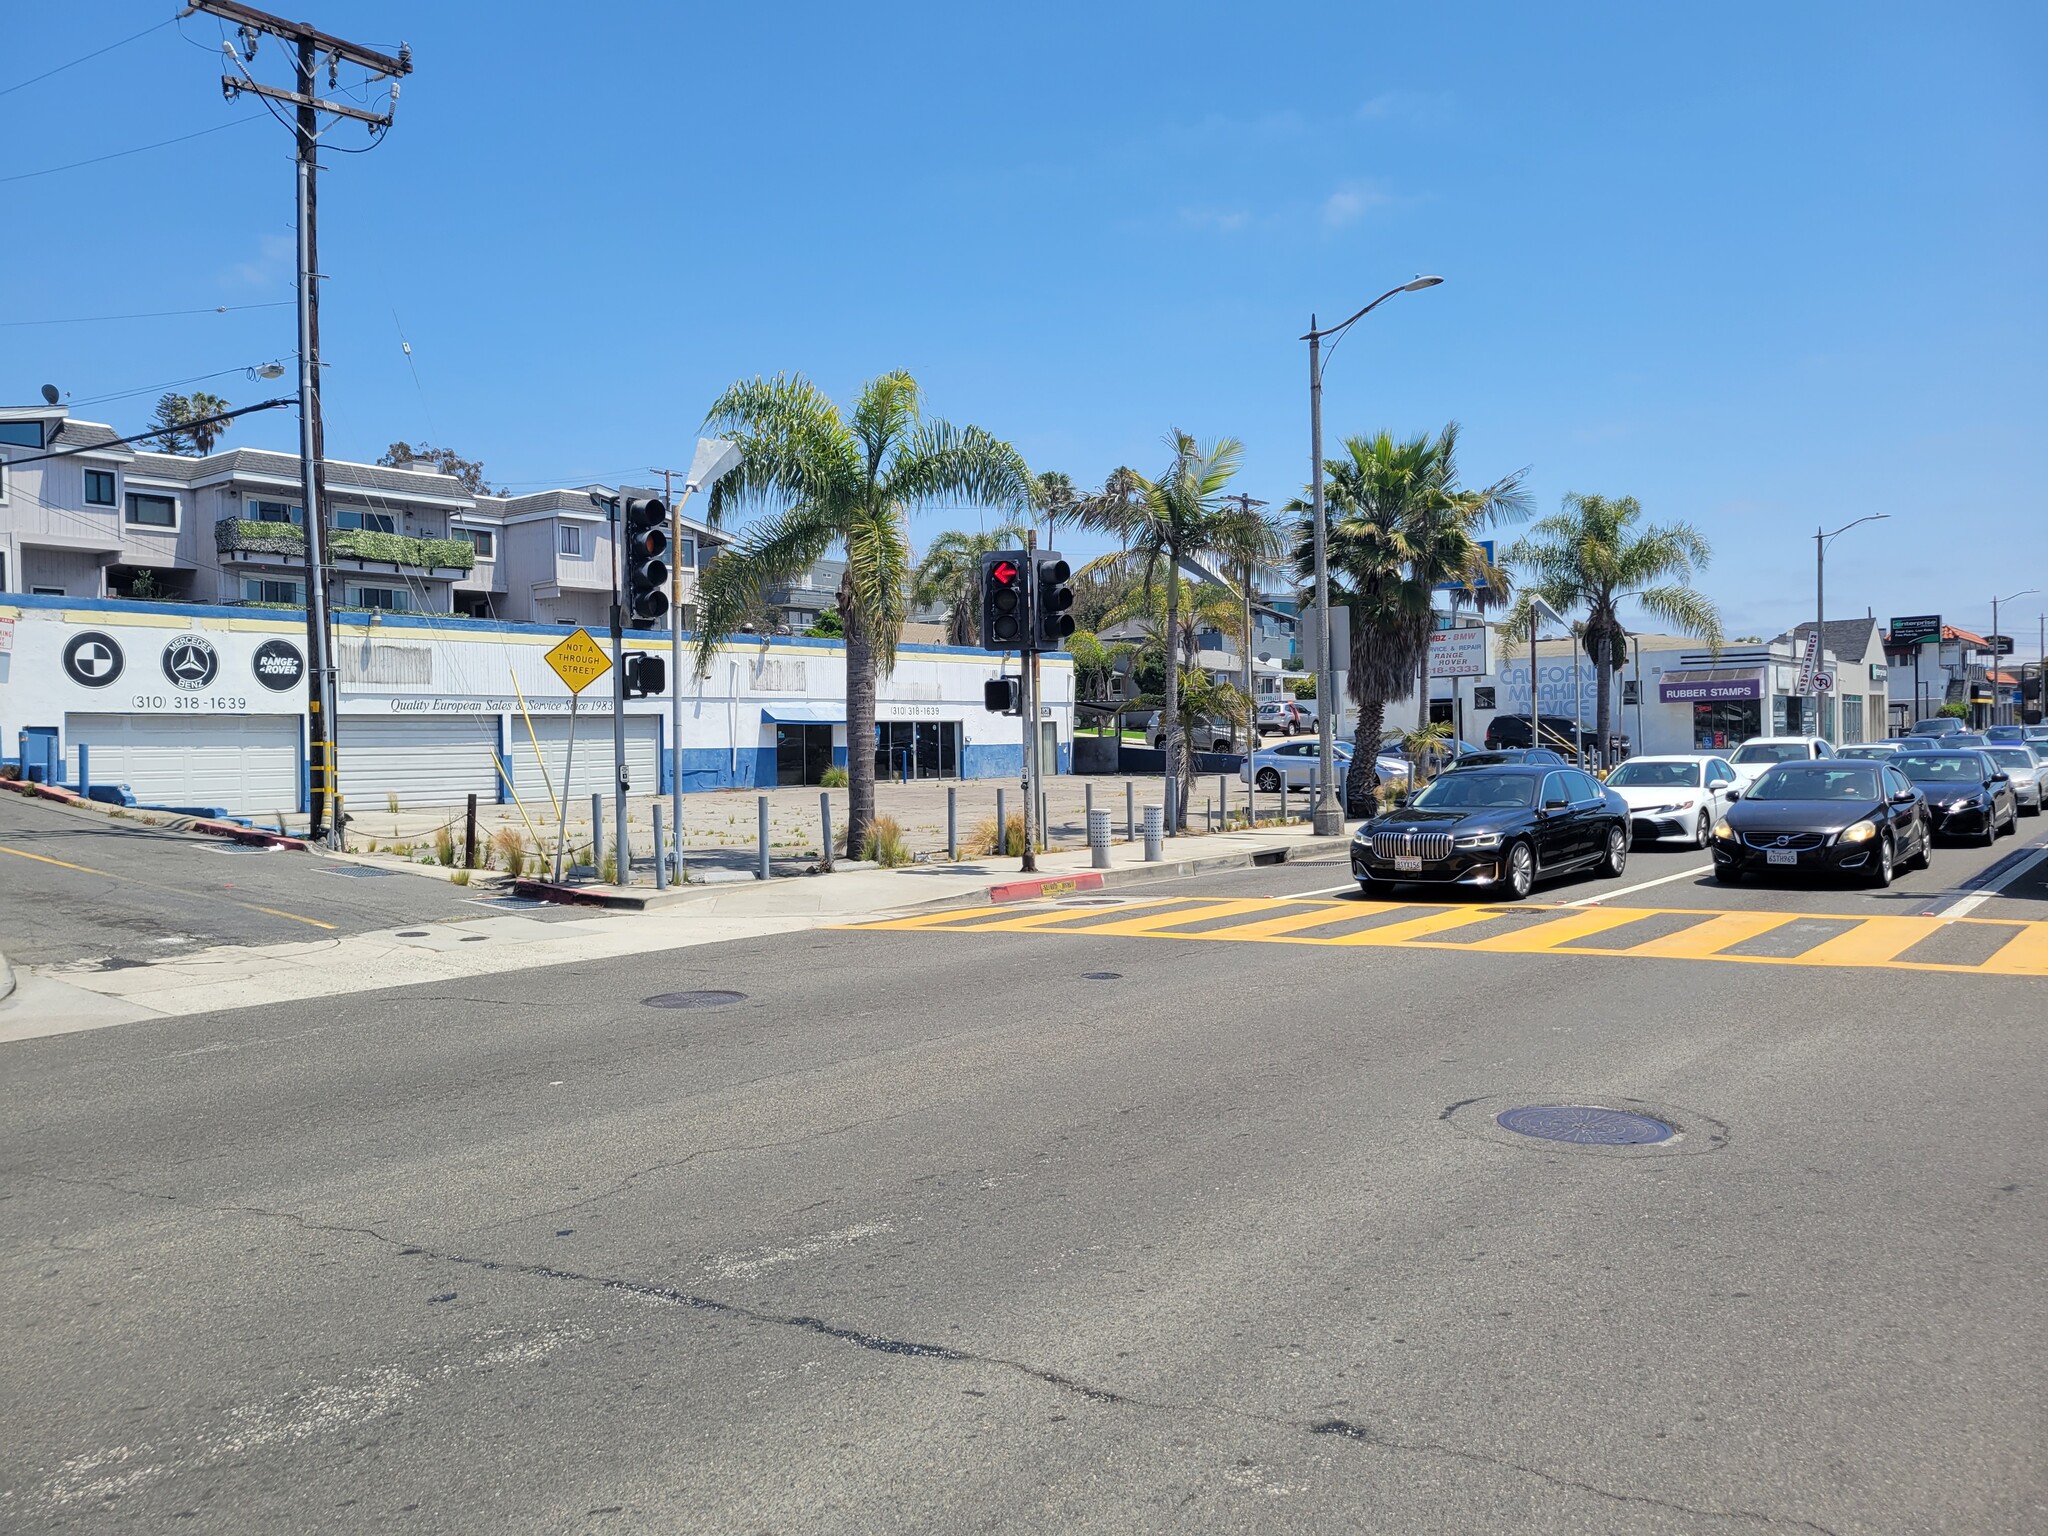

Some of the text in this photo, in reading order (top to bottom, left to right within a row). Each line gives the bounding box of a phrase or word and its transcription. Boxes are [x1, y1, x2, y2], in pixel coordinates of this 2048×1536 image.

[1453, 632, 1476, 641] BMW
[168, 636, 212, 654] MERCEDES
[566, 643, 583, 652] NOT
[260, 656, 293, 666] RANGE
[558, 653, 600, 664] THROUGH
[264, 665, 298, 675] ROVER
[562, 665, 595, 675] STREET
[1500, 664, 1598, 685] CALFORNI
[178, 678, 204, 689] BENZ
[1666, 687, 1751, 698] RUBBER STAMPS
[131, 696, 167, 709] (310)
[390, 697, 430, 713] Quality
[432, 698, 482, 713] European
[485, 699, 512, 711] Sales
[527, 699, 561, 711] Service
[591, 700, 613, 711] 1983
[908, 706, 940, 716] 318-1639
